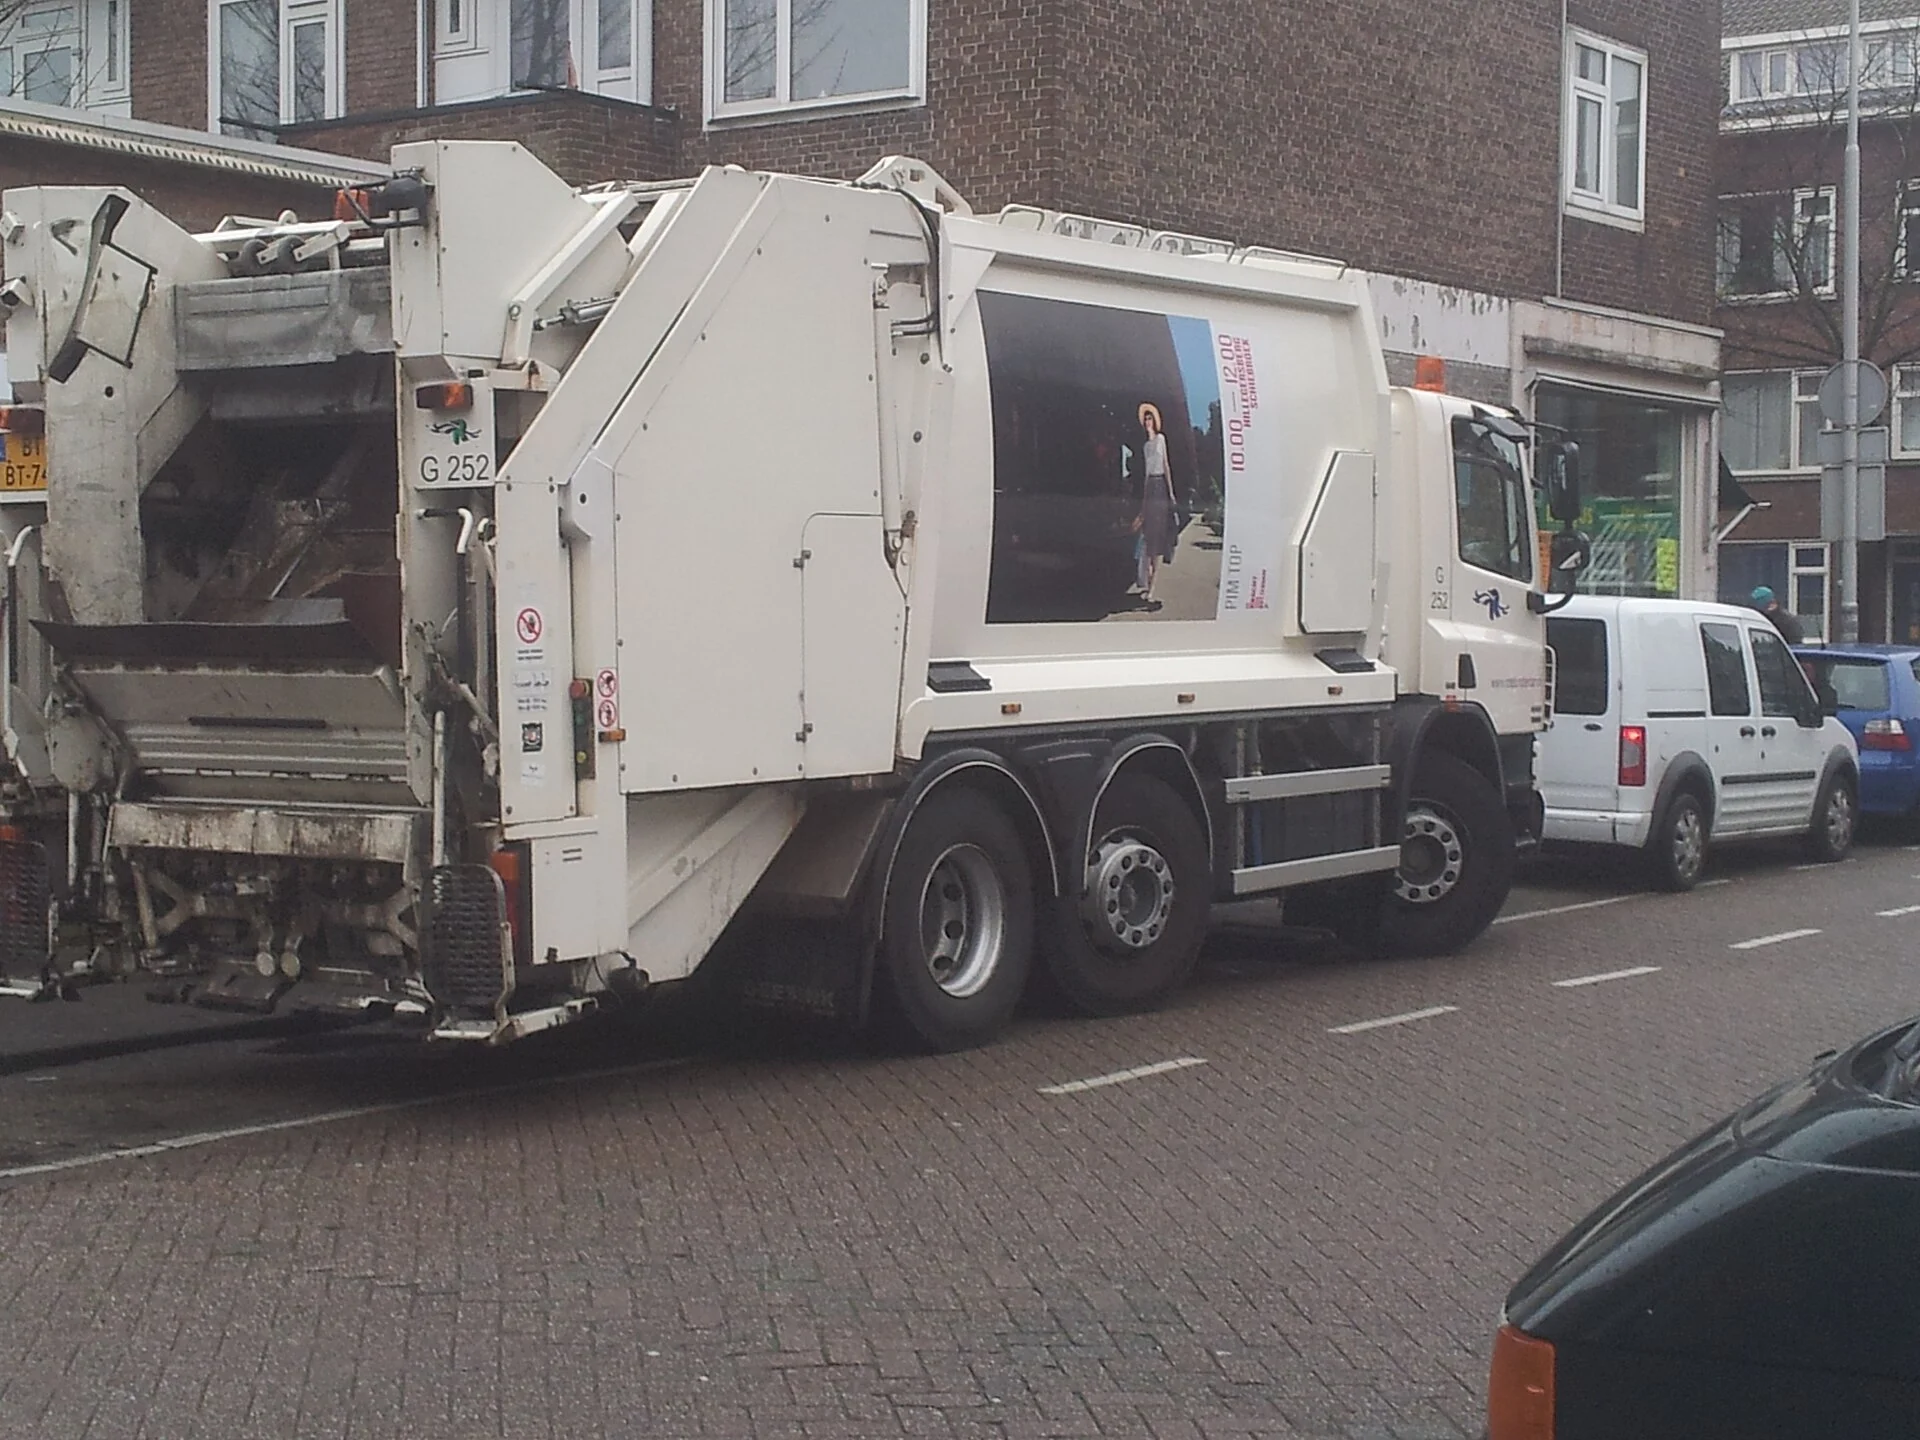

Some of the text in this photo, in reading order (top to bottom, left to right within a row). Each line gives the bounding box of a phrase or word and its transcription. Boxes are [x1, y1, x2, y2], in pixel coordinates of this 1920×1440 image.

[1218, 333, 1239, 384] 12.00
[1233, 336, 1252, 428] HILLEGERSBERG
[1242, 338, 1259, 409] SCHIEBROEK
[421, 454, 489, 482] G 252
[1228, 419, 1245, 472] 10.00
[1223, 544, 1242, 610] PIM TOP
[1430, 592, 1448, 609] 252
[1434, 566, 1445, 584] G
